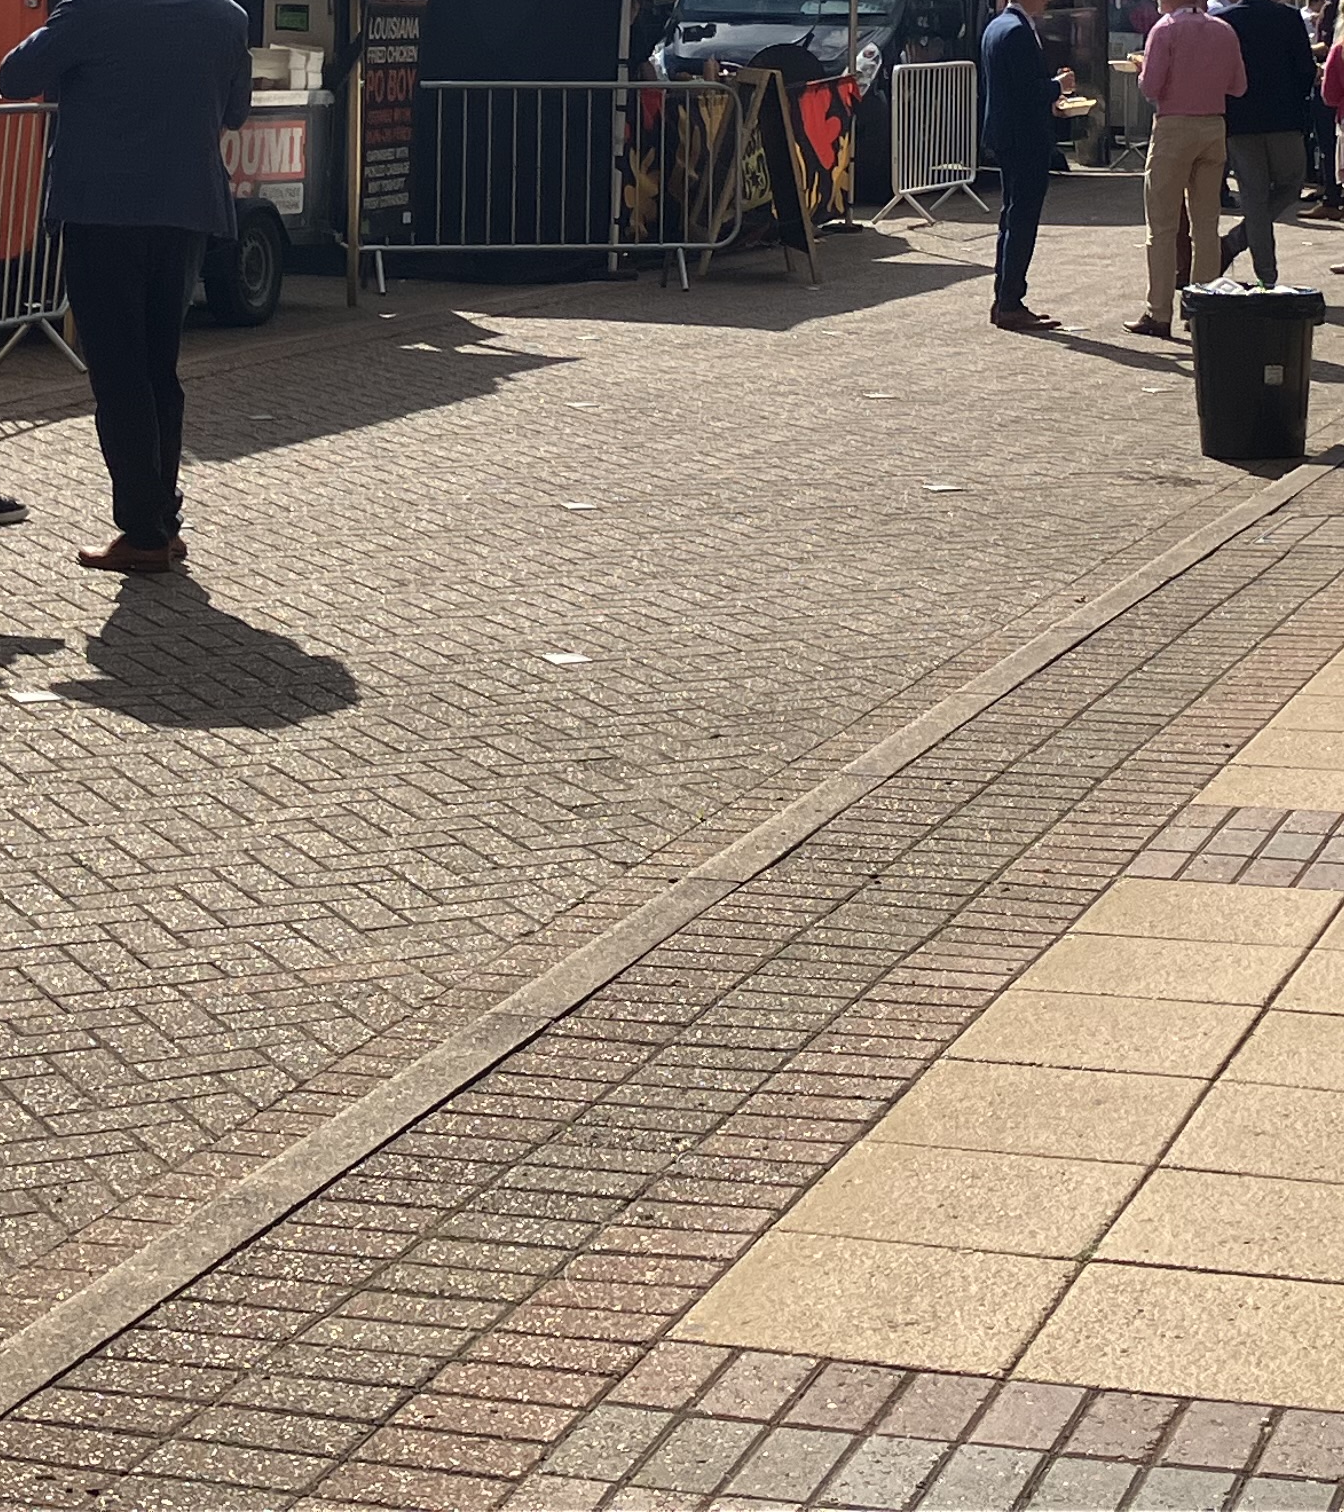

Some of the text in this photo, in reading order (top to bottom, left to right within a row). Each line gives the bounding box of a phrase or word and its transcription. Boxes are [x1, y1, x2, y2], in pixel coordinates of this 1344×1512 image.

[368, 16, 420, 41] LOUISIANA
[367, 45, 419, 64] FRIED CHICKEN
[366, 68, 416, 105] PO BOY
[219, 127, 303, 176] OUMI
